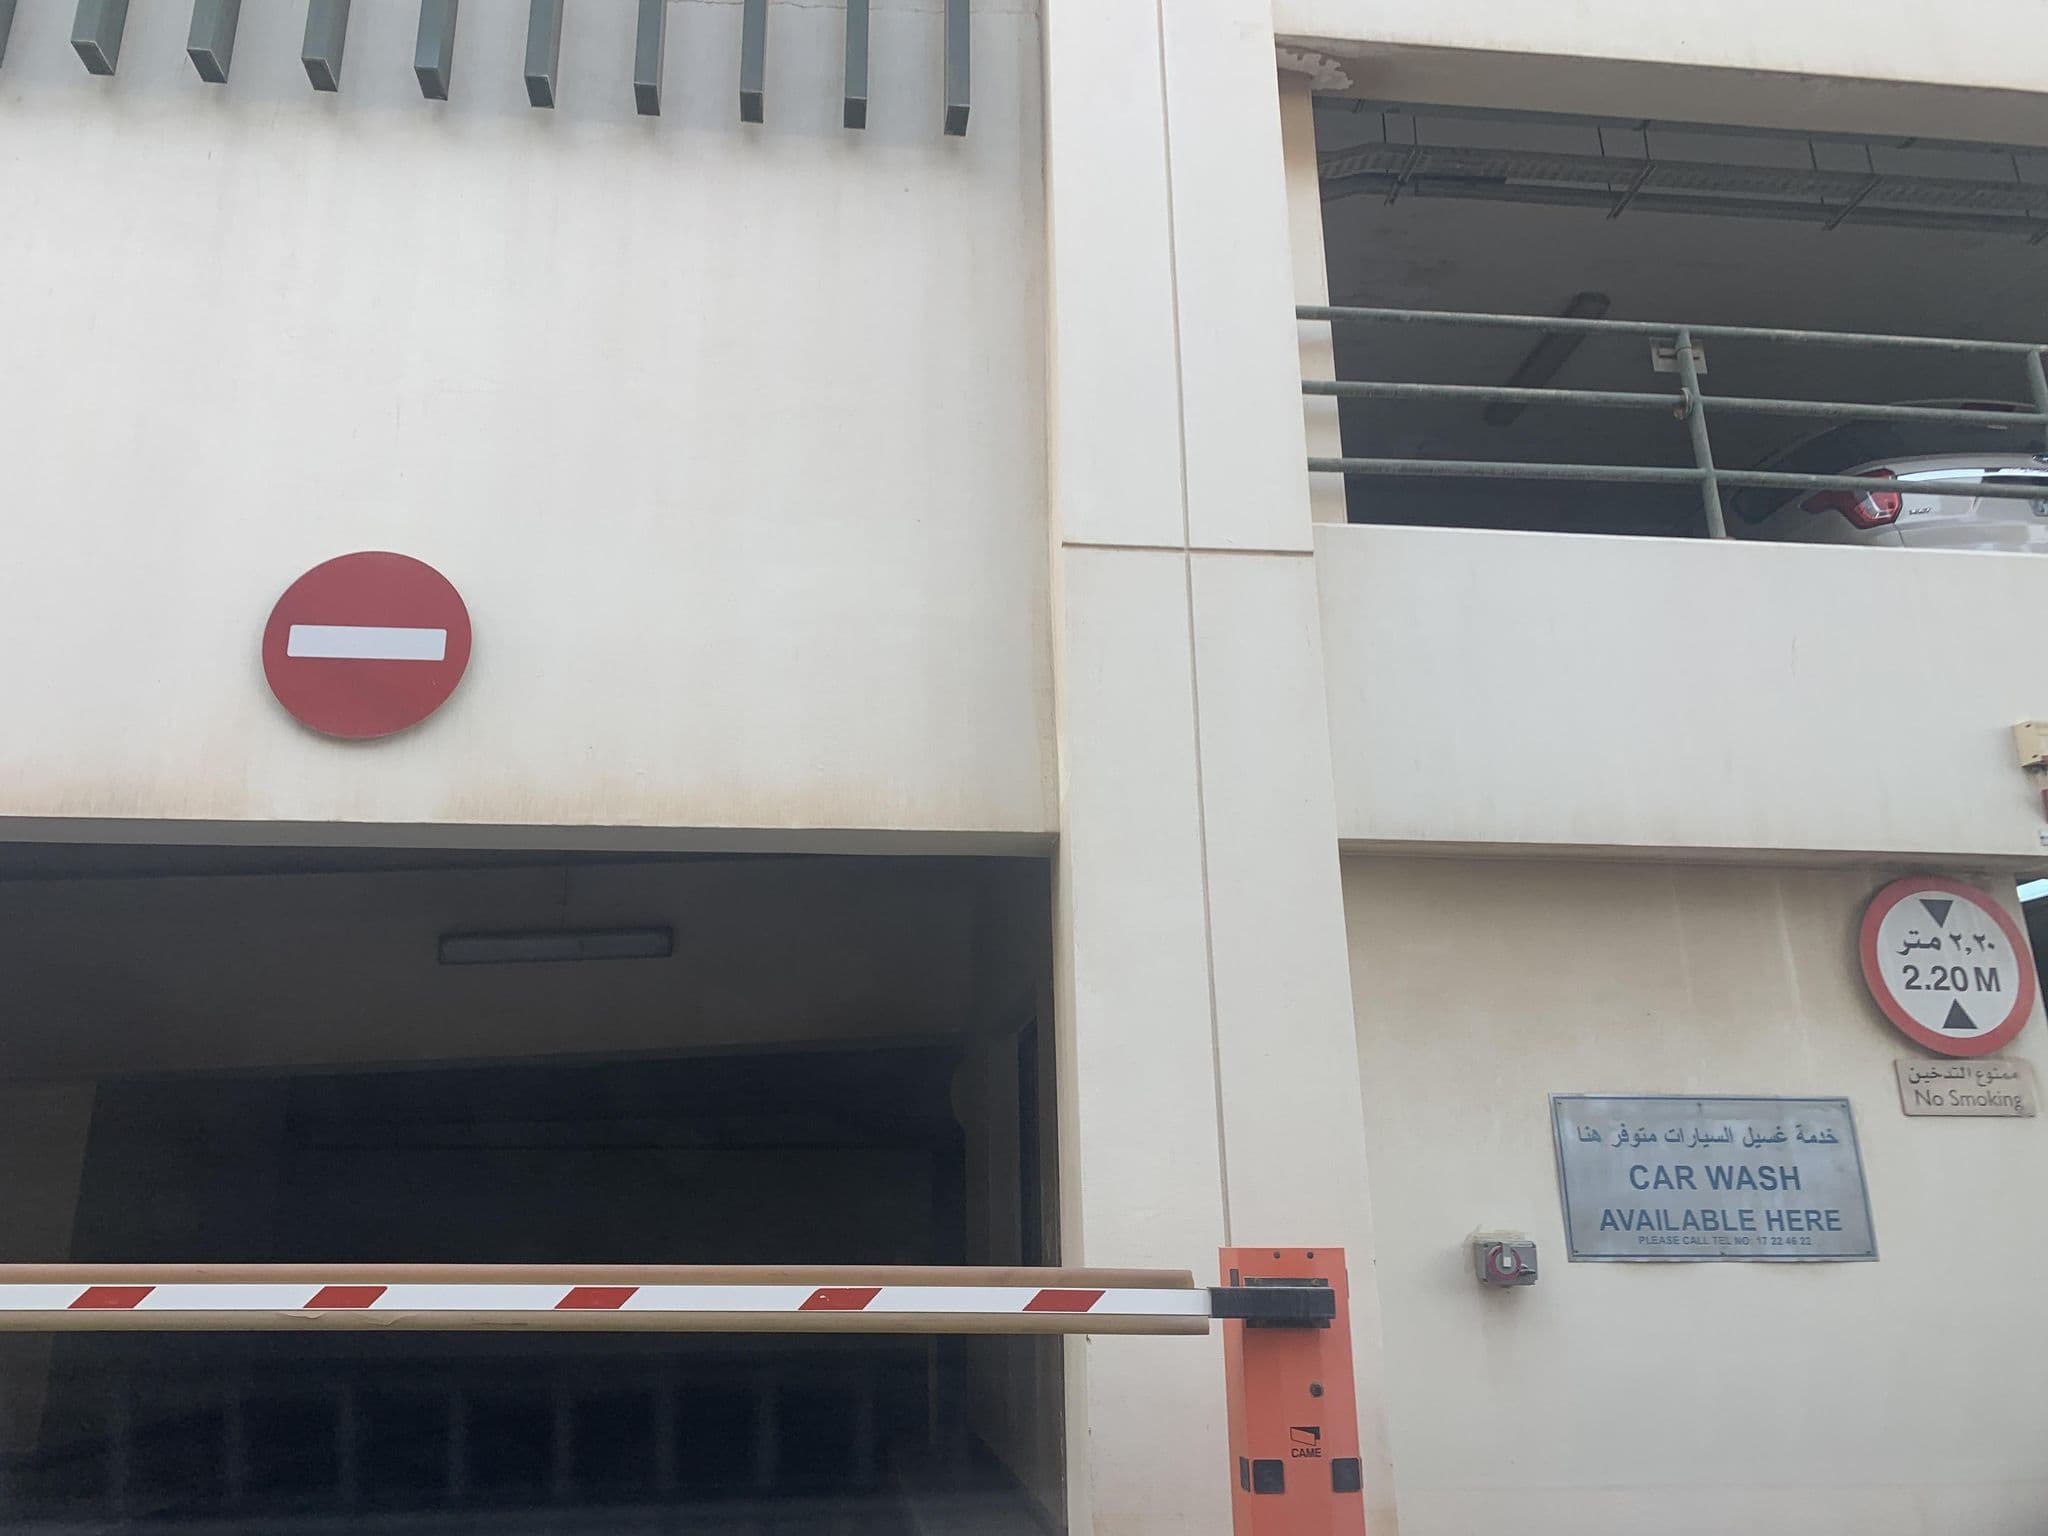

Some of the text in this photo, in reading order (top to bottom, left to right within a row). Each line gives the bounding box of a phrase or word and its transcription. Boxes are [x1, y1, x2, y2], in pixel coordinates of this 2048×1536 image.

[1896, 929, 1942, 955] متر
[1902, 964, 2001, 992] 2.20 M
[1908, 1066, 2019, 1087] ممنوع التدخين
[1914, 1089, 2024, 1112] No Smoking
[1576, 1123, 1839, 1148] خدمة غسيل السيارات متوفر هنا
[1628, 1164, 1801, 1191] CAR WASH
[1600, 1209, 1842, 1232] AVAILABLE HERE
[1638, 1236, 1680, 1245] PLEASE
[1682, 1236, 1709, 1245] CALL
[1712, 1236, 1732, 1245] TEL
[1771, 1236, 1783, 1246] 22
[1799, 1236, 1812, 1246] 22
[1291, 1447, 1322, 1458] CAME
